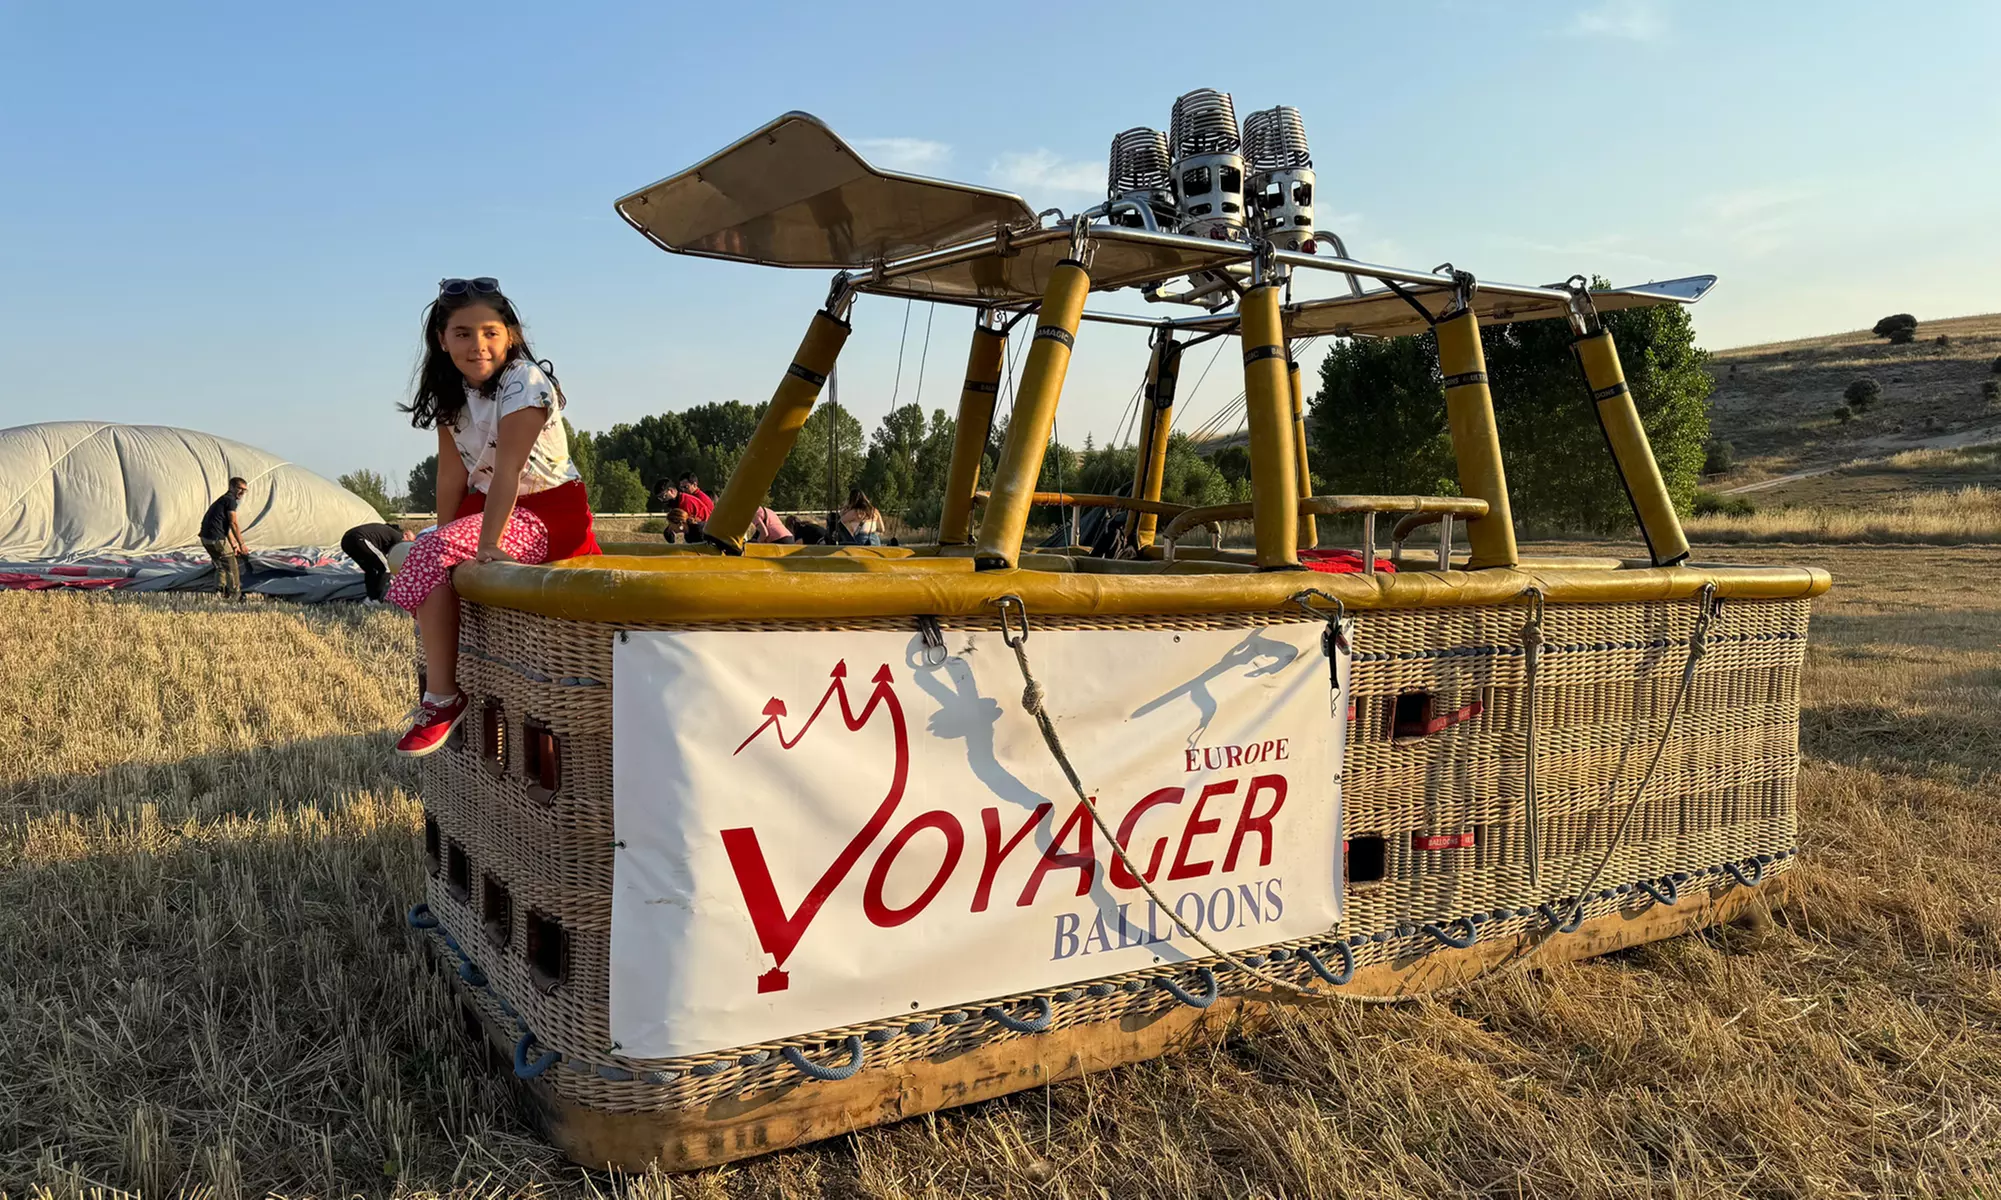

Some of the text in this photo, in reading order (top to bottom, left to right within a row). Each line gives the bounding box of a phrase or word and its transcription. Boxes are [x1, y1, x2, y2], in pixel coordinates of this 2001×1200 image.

[1184, 738, 1291, 773] EUROPE
[719, 700, 1289, 980] VOYAGER
[1049, 877, 1285, 962] BALLOONS
